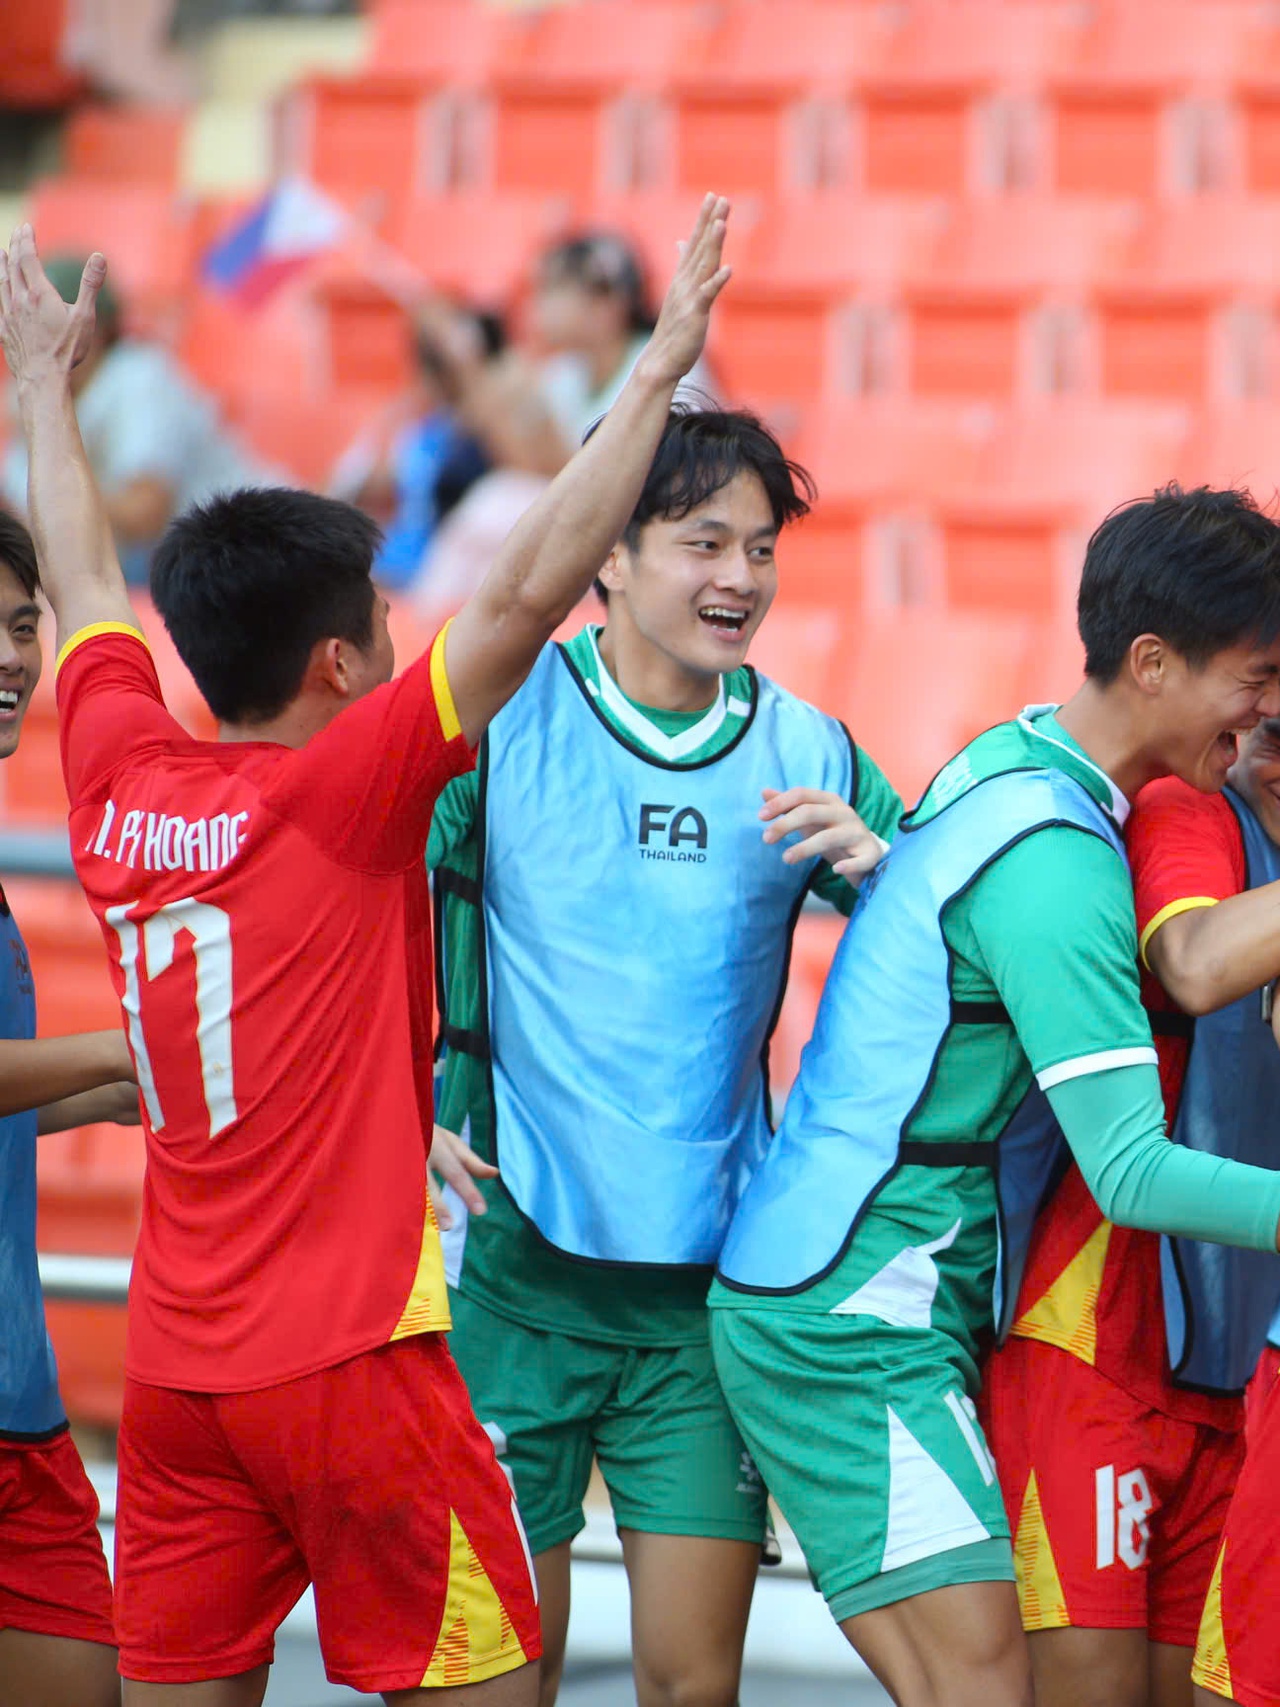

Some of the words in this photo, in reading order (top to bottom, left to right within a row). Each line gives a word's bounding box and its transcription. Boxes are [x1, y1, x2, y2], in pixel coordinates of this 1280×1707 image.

[638, 803, 708, 849] FA
[639, 848, 707, 863] THAILAND
[105, 896, 238, 1139] 17
[1095, 1464, 1154, 1571] 18
